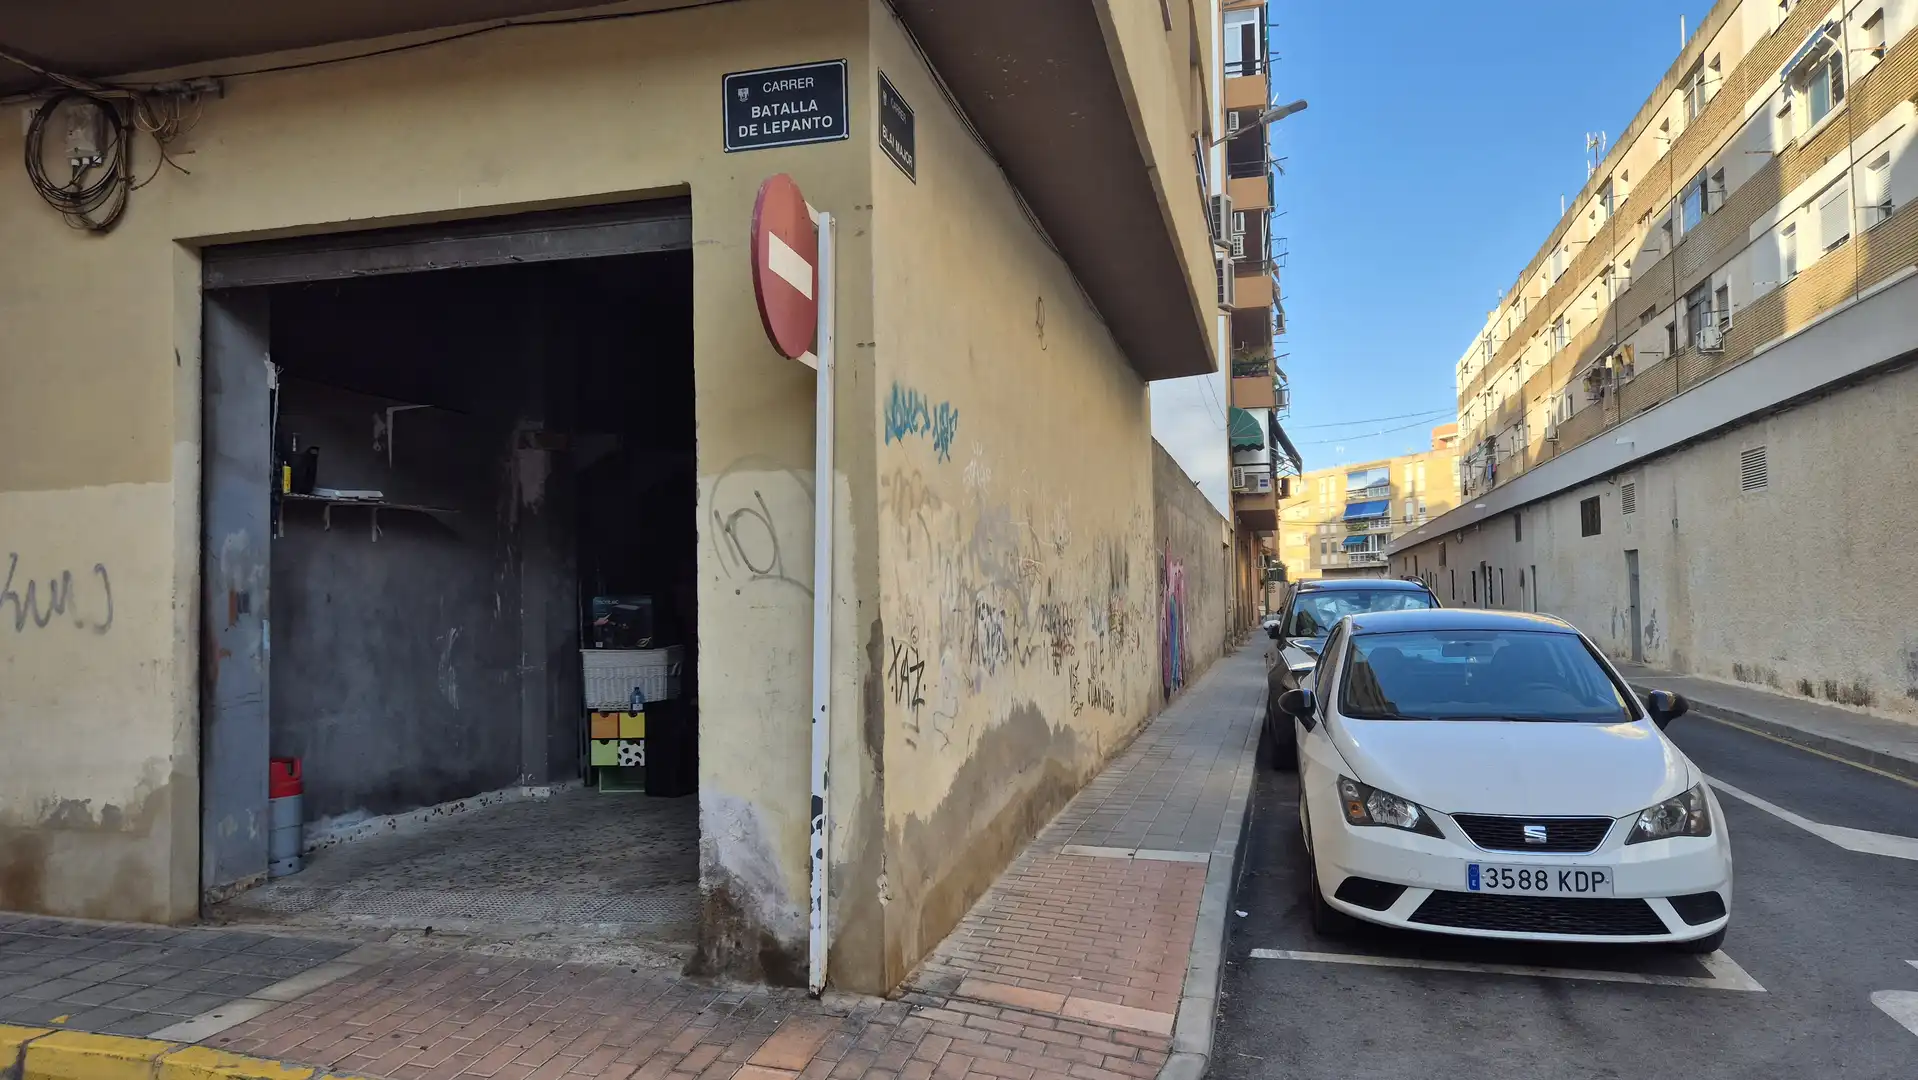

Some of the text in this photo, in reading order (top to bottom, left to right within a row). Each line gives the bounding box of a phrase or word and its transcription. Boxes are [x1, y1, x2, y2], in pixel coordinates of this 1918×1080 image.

[762, 77, 814, 93] CARRER
[751, 99, 818, 118] BATALLA
[738, 115, 833, 138] DE LEPANTO
[882, 123, 913, 169] BLAI MAJOR
[1485, 867, 1549, 892] 3588
[1558, 870, 1606, 893] KDP
